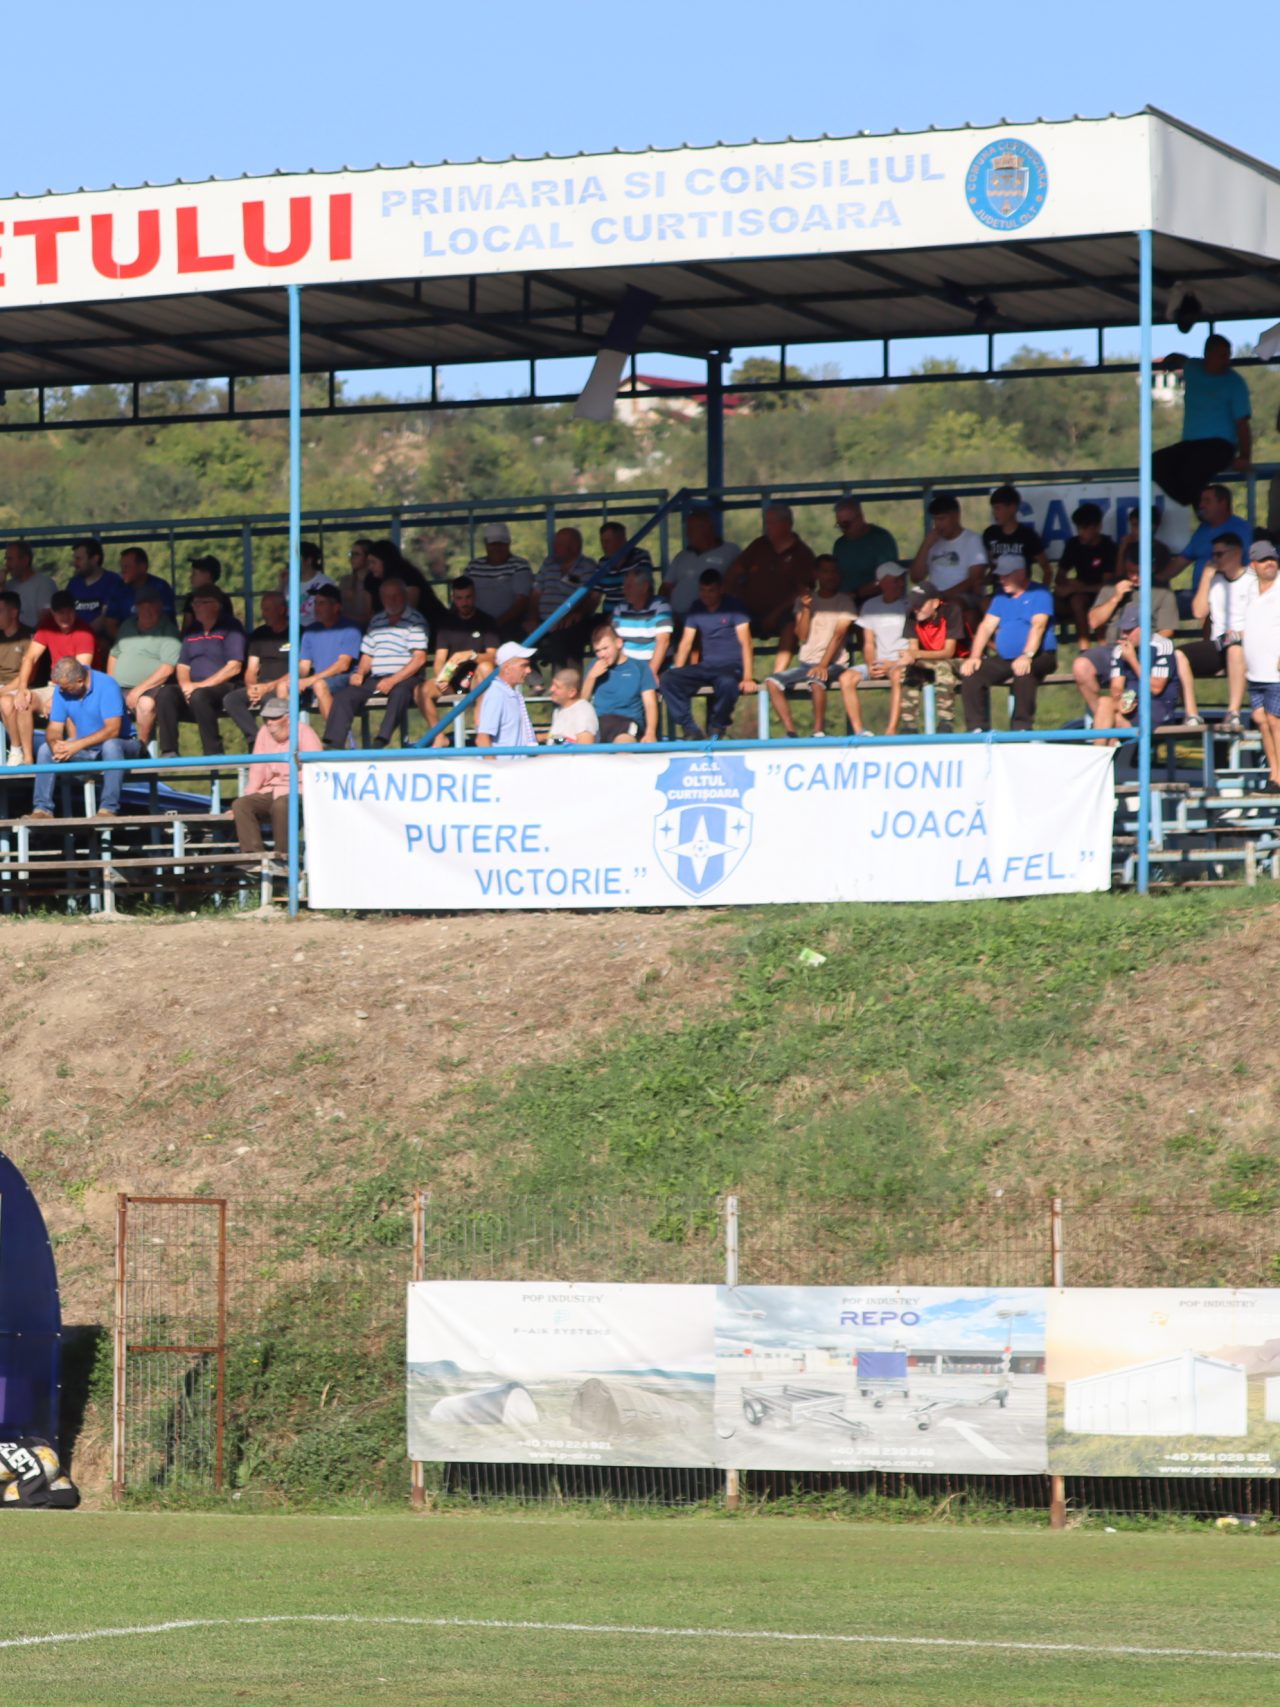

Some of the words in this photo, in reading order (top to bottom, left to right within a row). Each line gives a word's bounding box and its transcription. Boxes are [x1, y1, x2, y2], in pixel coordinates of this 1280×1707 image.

[382, 175, 608, 217] PRIMARIA
[624, 171, 666, 199] SI
[684, 153, 946, 196] CONSILIUL
[422, 221, 575, 257] LOCAL
[590, 199, 903, 246] CURTISOARA
[689, 762, 721, 772] A.C.S.
[682, 775, 726, 787] OLTUL
[870, 800, 988, 839] JOACĂ
[405, 823, 550, 854] PUTERE.
[954, 857, 992, 888] LA
[547, 1294, 605, 1304] INDUSTRY
[865, 1296, 920, 1306] INDUSTRY
[840, 1310, 921, 1327] REPO
